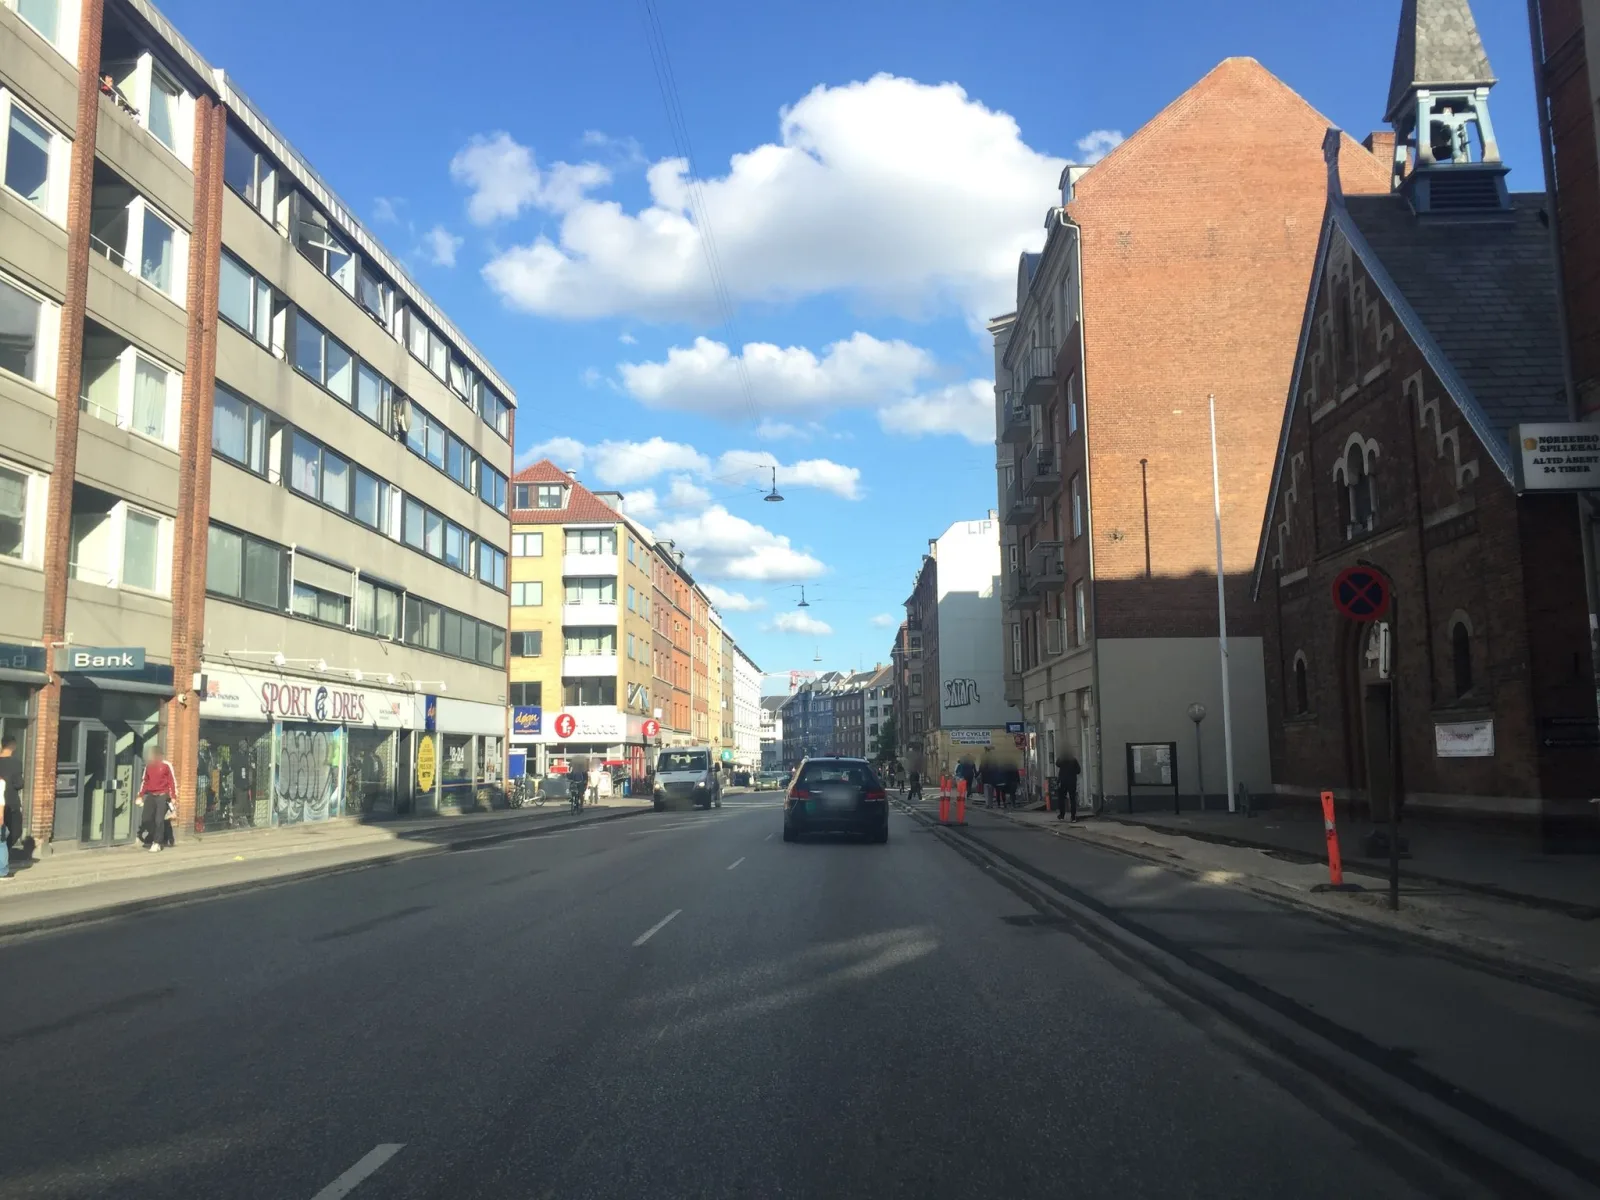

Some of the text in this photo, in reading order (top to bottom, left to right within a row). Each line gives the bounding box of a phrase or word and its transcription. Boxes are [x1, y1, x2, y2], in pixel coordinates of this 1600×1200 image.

[1539, 435, 1599, 444] NØRREBRO
[1566, 455, 1598, 464] ÅBENT
[74, 652, 136, 667] Bank
[260, 681, 312, 716] SPORT
[331, 690, 365, 721] DRES
